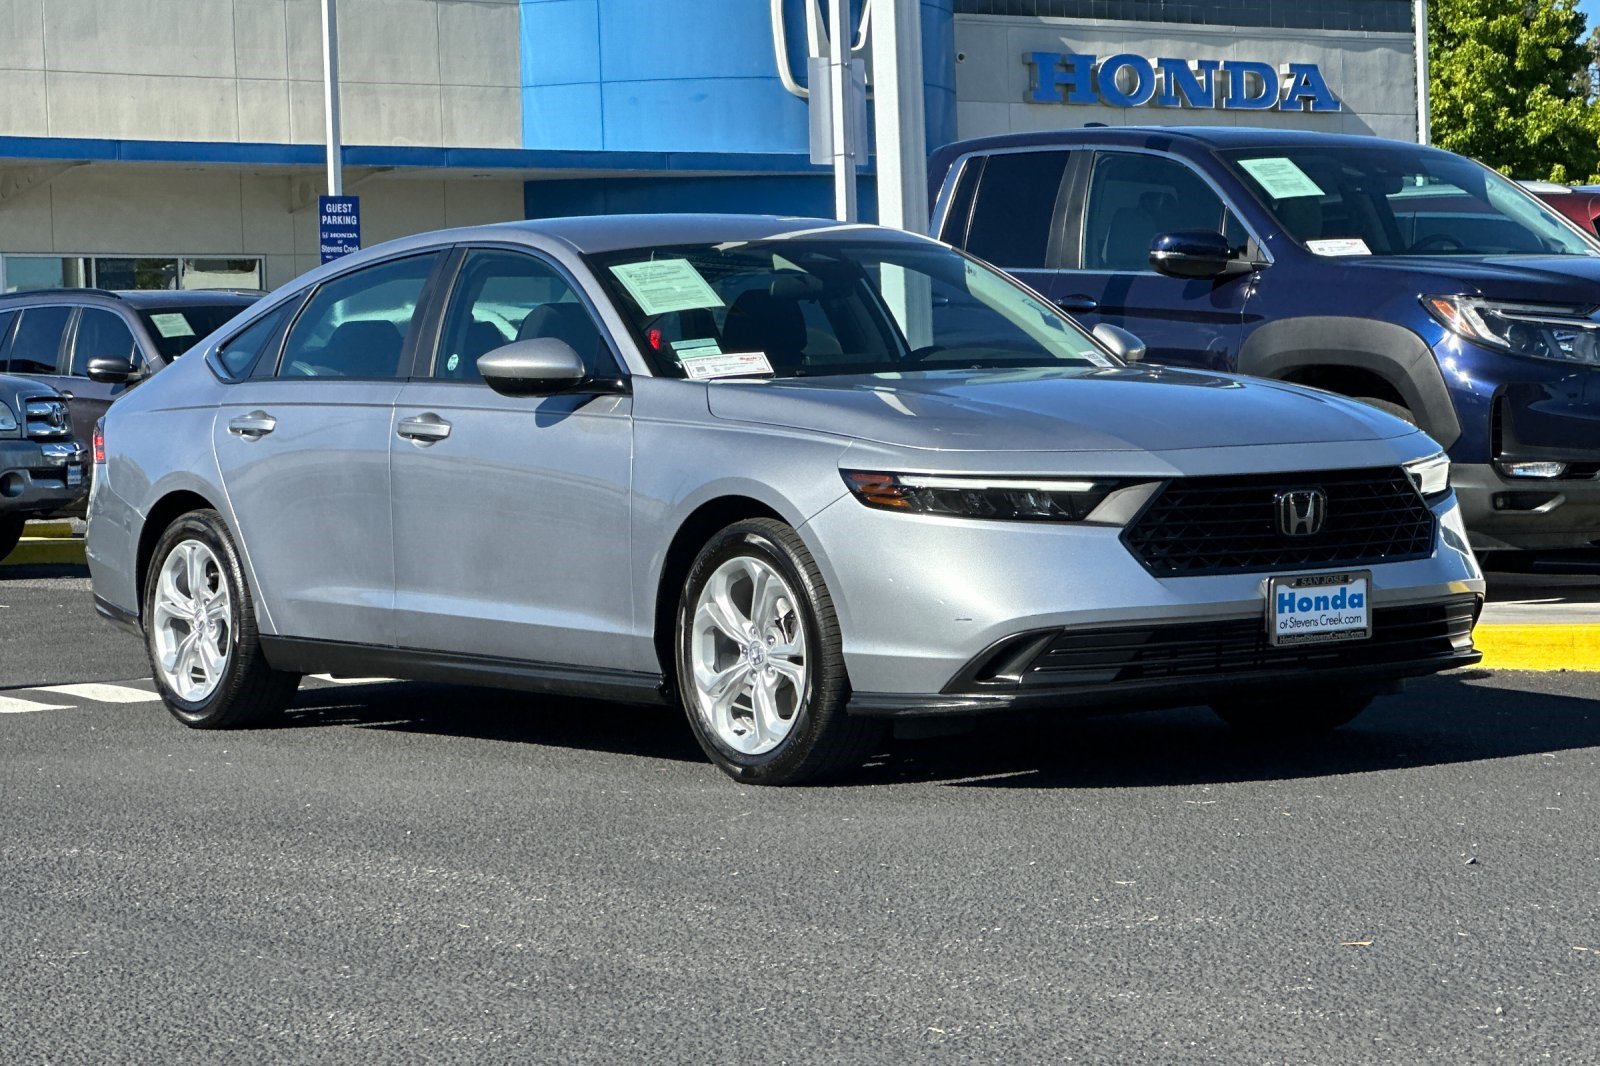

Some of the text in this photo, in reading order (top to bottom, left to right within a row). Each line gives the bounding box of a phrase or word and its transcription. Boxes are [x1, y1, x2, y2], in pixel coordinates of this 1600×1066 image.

[1027, 51, 1342, 113] HONDA
[326, 203, 352, 213] GUEST
[322, 216, 357, 225] PARKING
[321, 244, 342, 252] Stevens
[1301, 575, 1344, 586] SAN JOSE
[1277, 587, 1364, 614] Honda
[1279, 612, 1362, 630] of Stevens Creek.com
